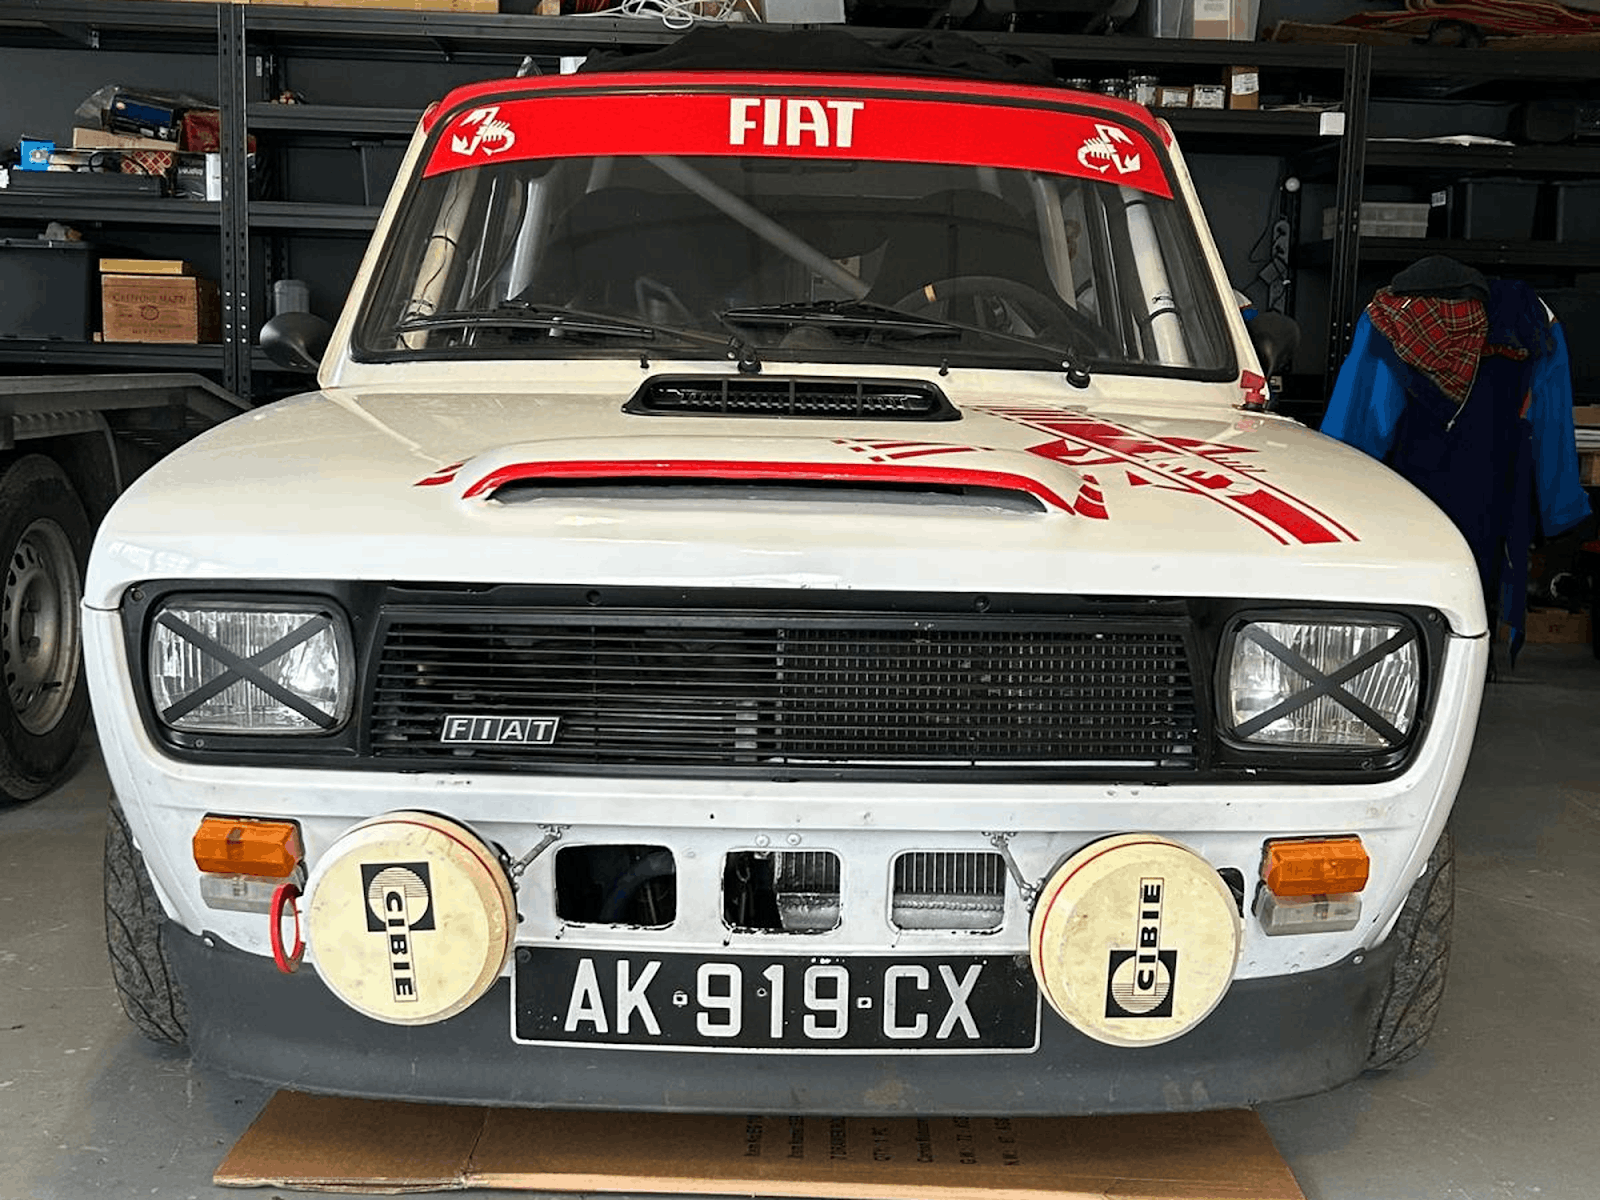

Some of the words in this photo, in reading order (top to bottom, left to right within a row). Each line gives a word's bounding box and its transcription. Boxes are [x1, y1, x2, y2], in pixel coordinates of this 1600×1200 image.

[729, 97, 865, 148] FIAT
[449, 719, 554, 741] FIAT
[386, 890, 413, 996] CIBIE
[1137, 884, 1161, 991] CIBIE
